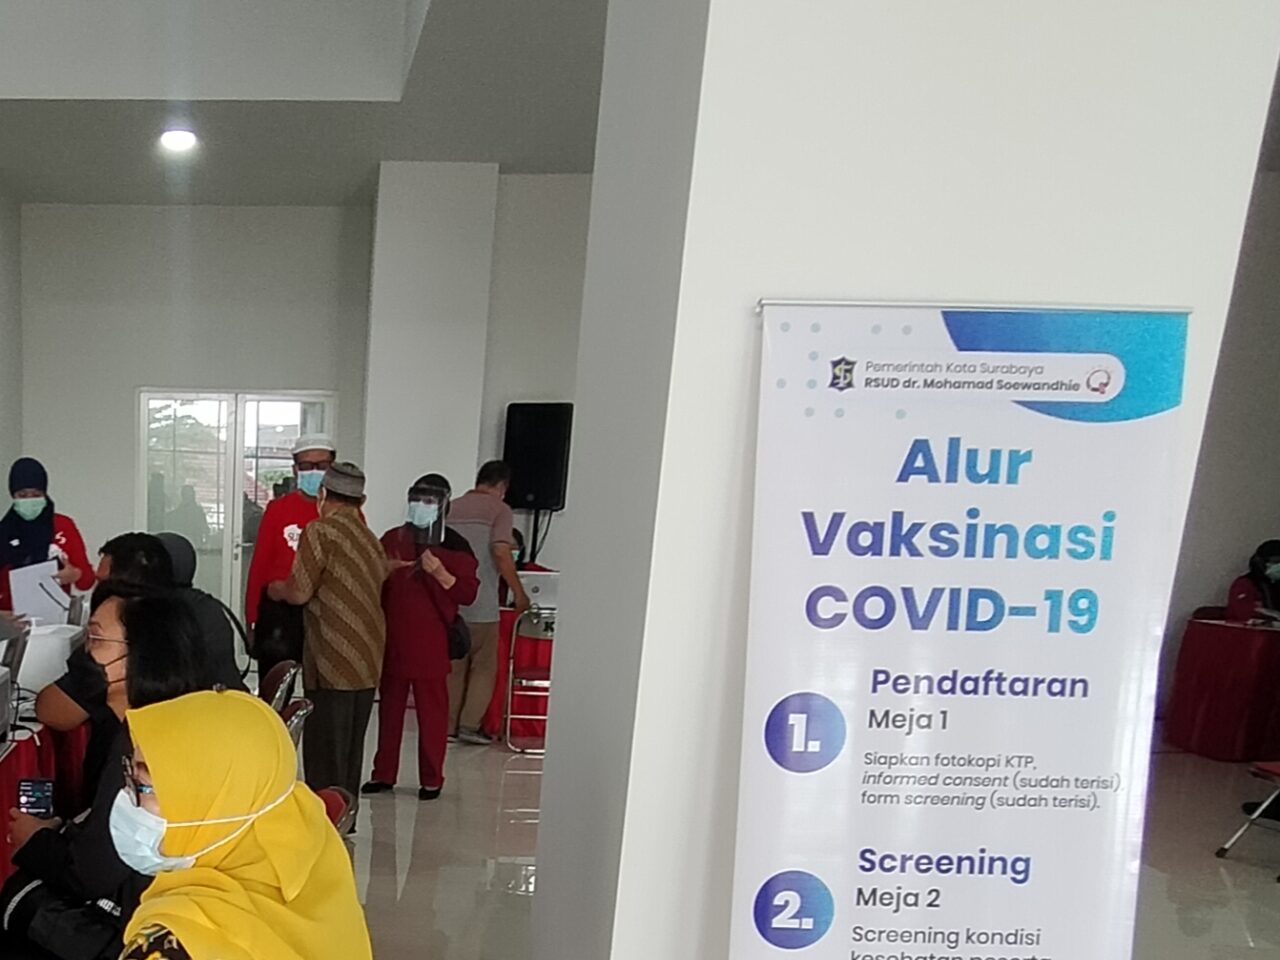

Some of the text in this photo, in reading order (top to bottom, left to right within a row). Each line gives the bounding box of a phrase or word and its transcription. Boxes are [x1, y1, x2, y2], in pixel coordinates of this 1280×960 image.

[865, 360, 1045, 379] Pemerintah Kota Surabaya
[864, 376, 1081, 392] RSUD dr. Mohamad Soewandhie
[895, 436, 1033, 485] Alur
[801, 507, 1117, 561] Vaksinasi
[805, 585, 1099, 635] COVID-19
[871, 668, 1089, 698] Pendaftaran
[787, 713, 822, 753] 1.
[867, 708, 948, 736] Meja 1
[863, 751, 931, 770] Siapkan
[934, 752, 1002, 773] fotokopi
[861, 770, 941, 787] informed
[941, 775, 1010, 788] consent
[1012, 768, 1071, 791] (sudah
[860, 787, 1101, 812] form screening (sudah terisi).
[858, 847, 1031, 885] Screening
[771, 890, 814, 930] 2.
[855, 885, 941, 913] Meja 2
[851, 925, 1042, 948] Screening kondisi
